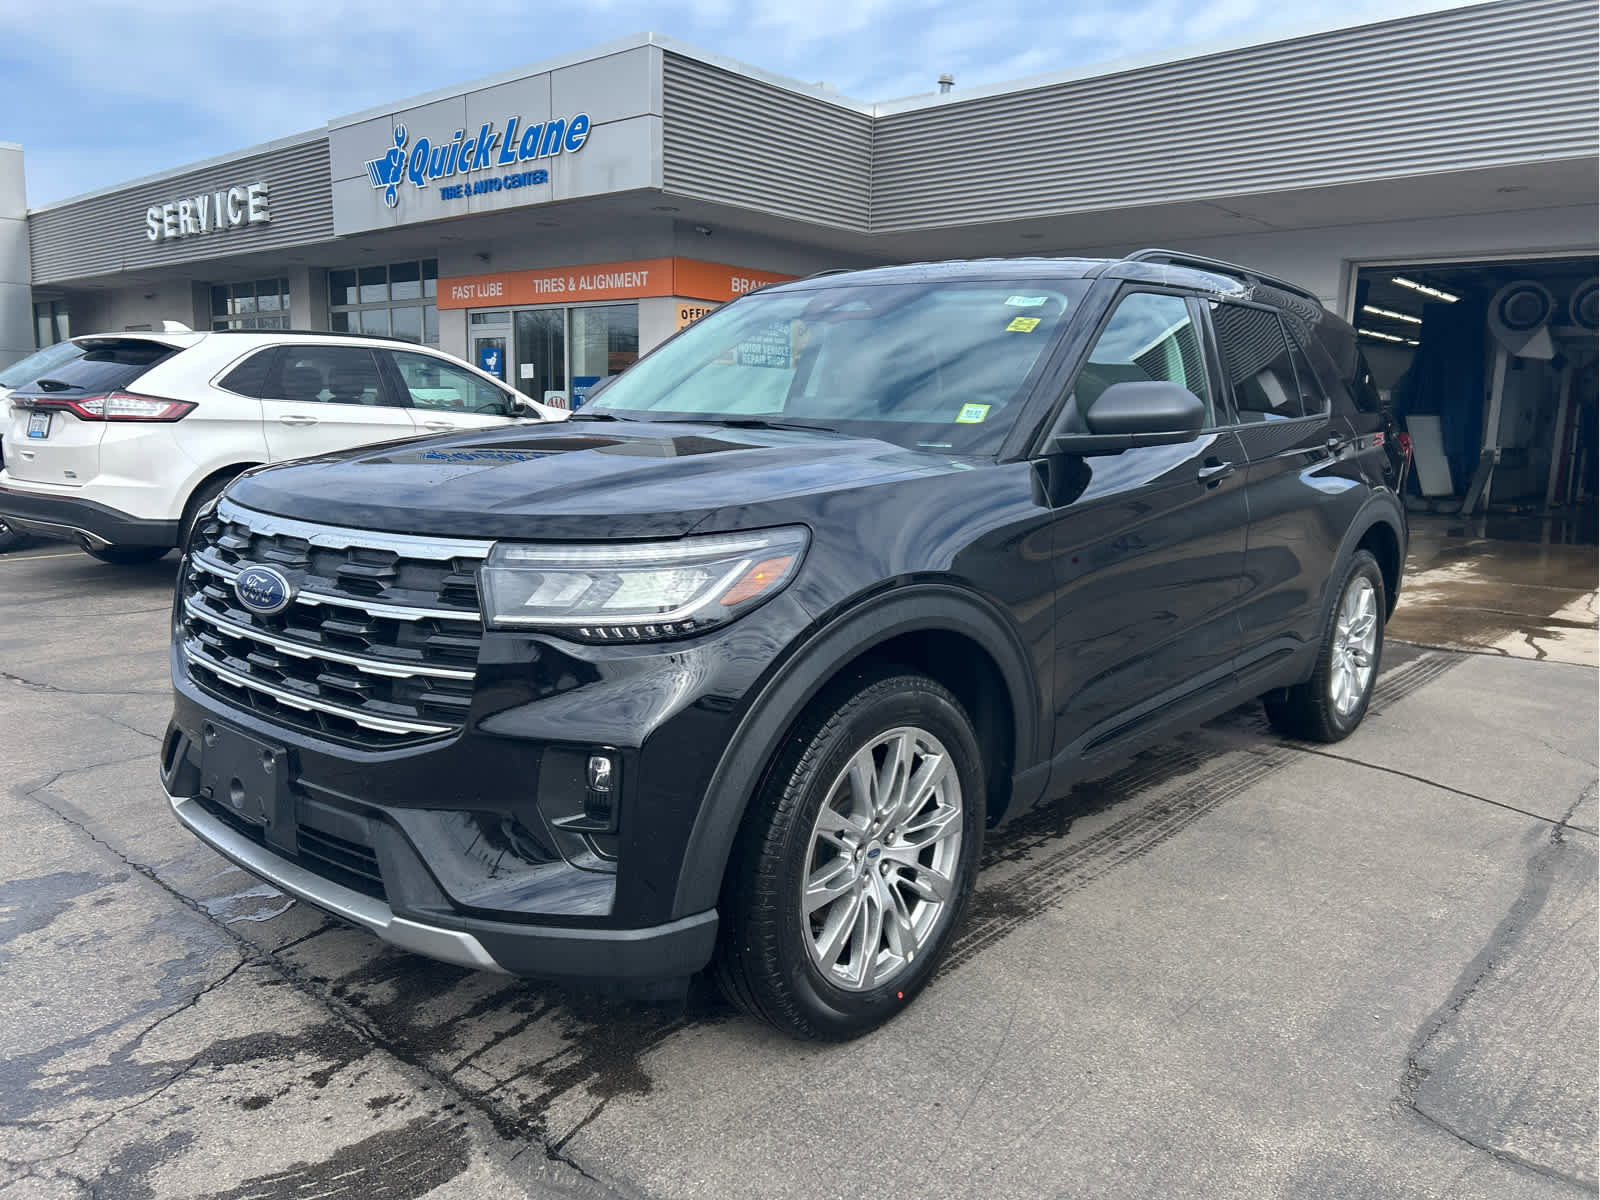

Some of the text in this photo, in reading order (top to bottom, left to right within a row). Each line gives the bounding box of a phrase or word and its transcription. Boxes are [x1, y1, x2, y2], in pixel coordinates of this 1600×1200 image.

[408, 113, 591, 188] Quick Lane
[440, 169, 548, 200] TIRE & AUTO CENTER
[146, 182, 270, 241] SERVICE
[452, 282, 503, 299] FAST LUBE
[533, 270, 649, 293] TIRES & ALIGNMENT
[242, 574, 274, 603] Ford
